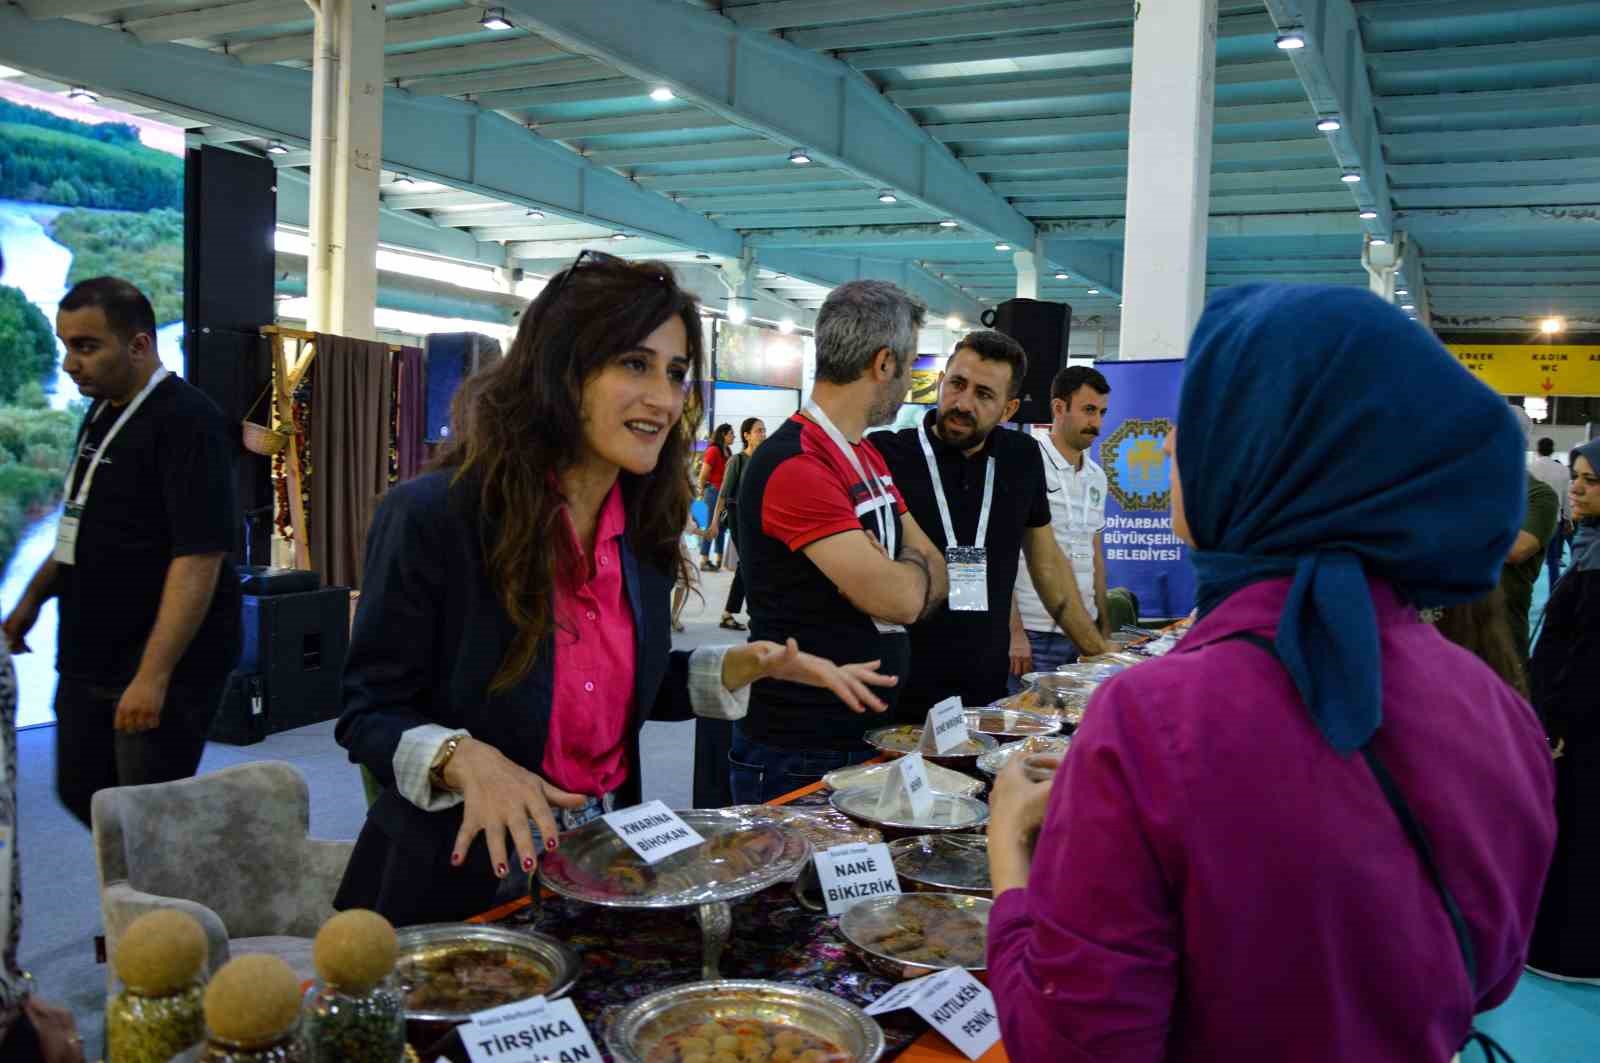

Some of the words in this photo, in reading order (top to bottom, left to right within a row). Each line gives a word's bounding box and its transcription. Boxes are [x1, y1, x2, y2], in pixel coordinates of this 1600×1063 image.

[1531, 353, 1568, 361] KADIN
[1541, 364, 1559, 372] WC
[1107, 547, 1182, 561] BELEDİYESİ
[827, 878, 897, 901] BİKİZRİK
[478, 1019, 575, 1057] TİRŞİKA
